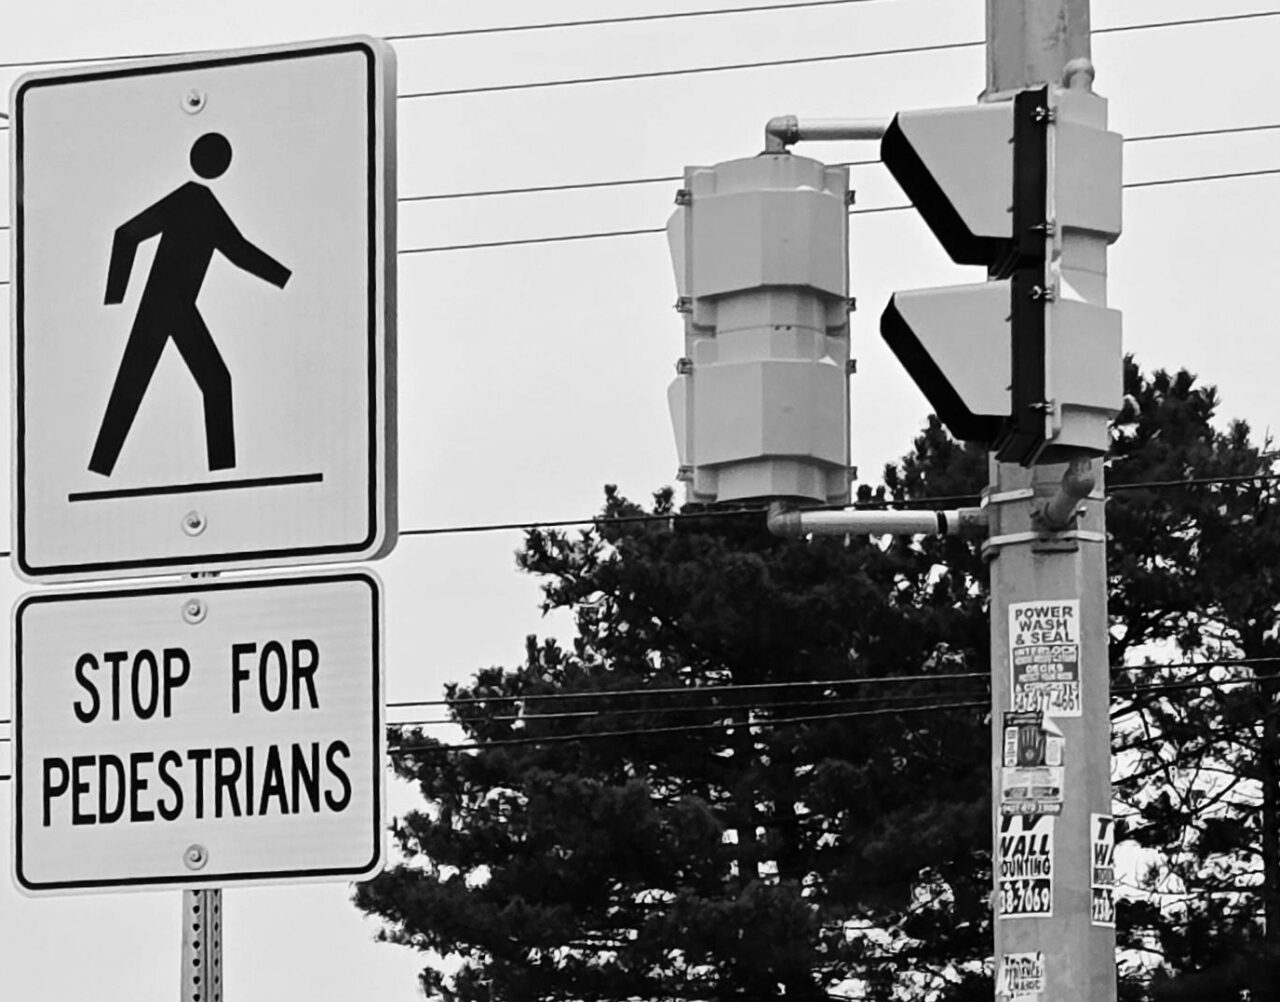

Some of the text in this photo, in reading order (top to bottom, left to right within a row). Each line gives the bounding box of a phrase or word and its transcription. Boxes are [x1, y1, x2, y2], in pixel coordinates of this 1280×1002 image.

[1015, 606, 1074, 620] POWER
[1019, 619, 1068, 632] WASH
[1031, 631, 1074, 644] SEAL
[73, 639, 320, 723] STOP FOR
[42, 740, 352, 827] PEDESTRIANS
[1000, 858, 1051, 878] OUNTING
[999, 887, 1050, 913] 38-7069
